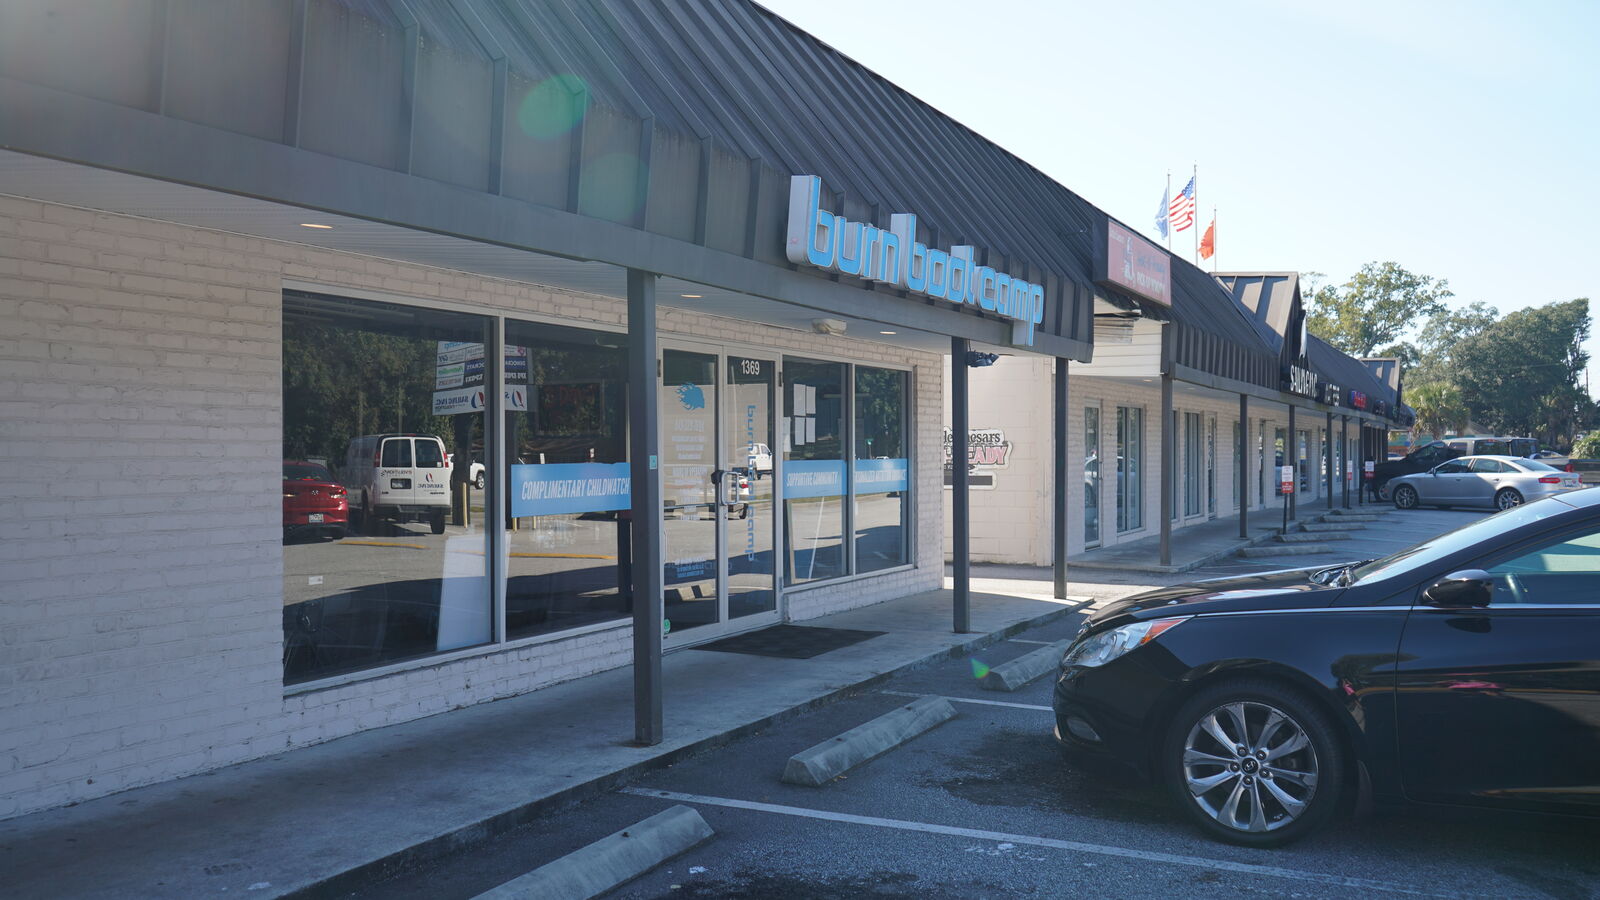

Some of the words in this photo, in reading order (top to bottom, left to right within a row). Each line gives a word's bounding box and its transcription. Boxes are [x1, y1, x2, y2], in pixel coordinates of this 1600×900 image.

[800, 174, 900, 286] burn
[904, 212, 975, 305] boot
[977, 265, 1045, 347] camp
[741, 360, 760, 376] 1369
[968, 432, 1001, 443] esars
[521, 479, 586, 501] COMPLIMENTARY
[587, 478, 631, 497] CHILDWATCH
